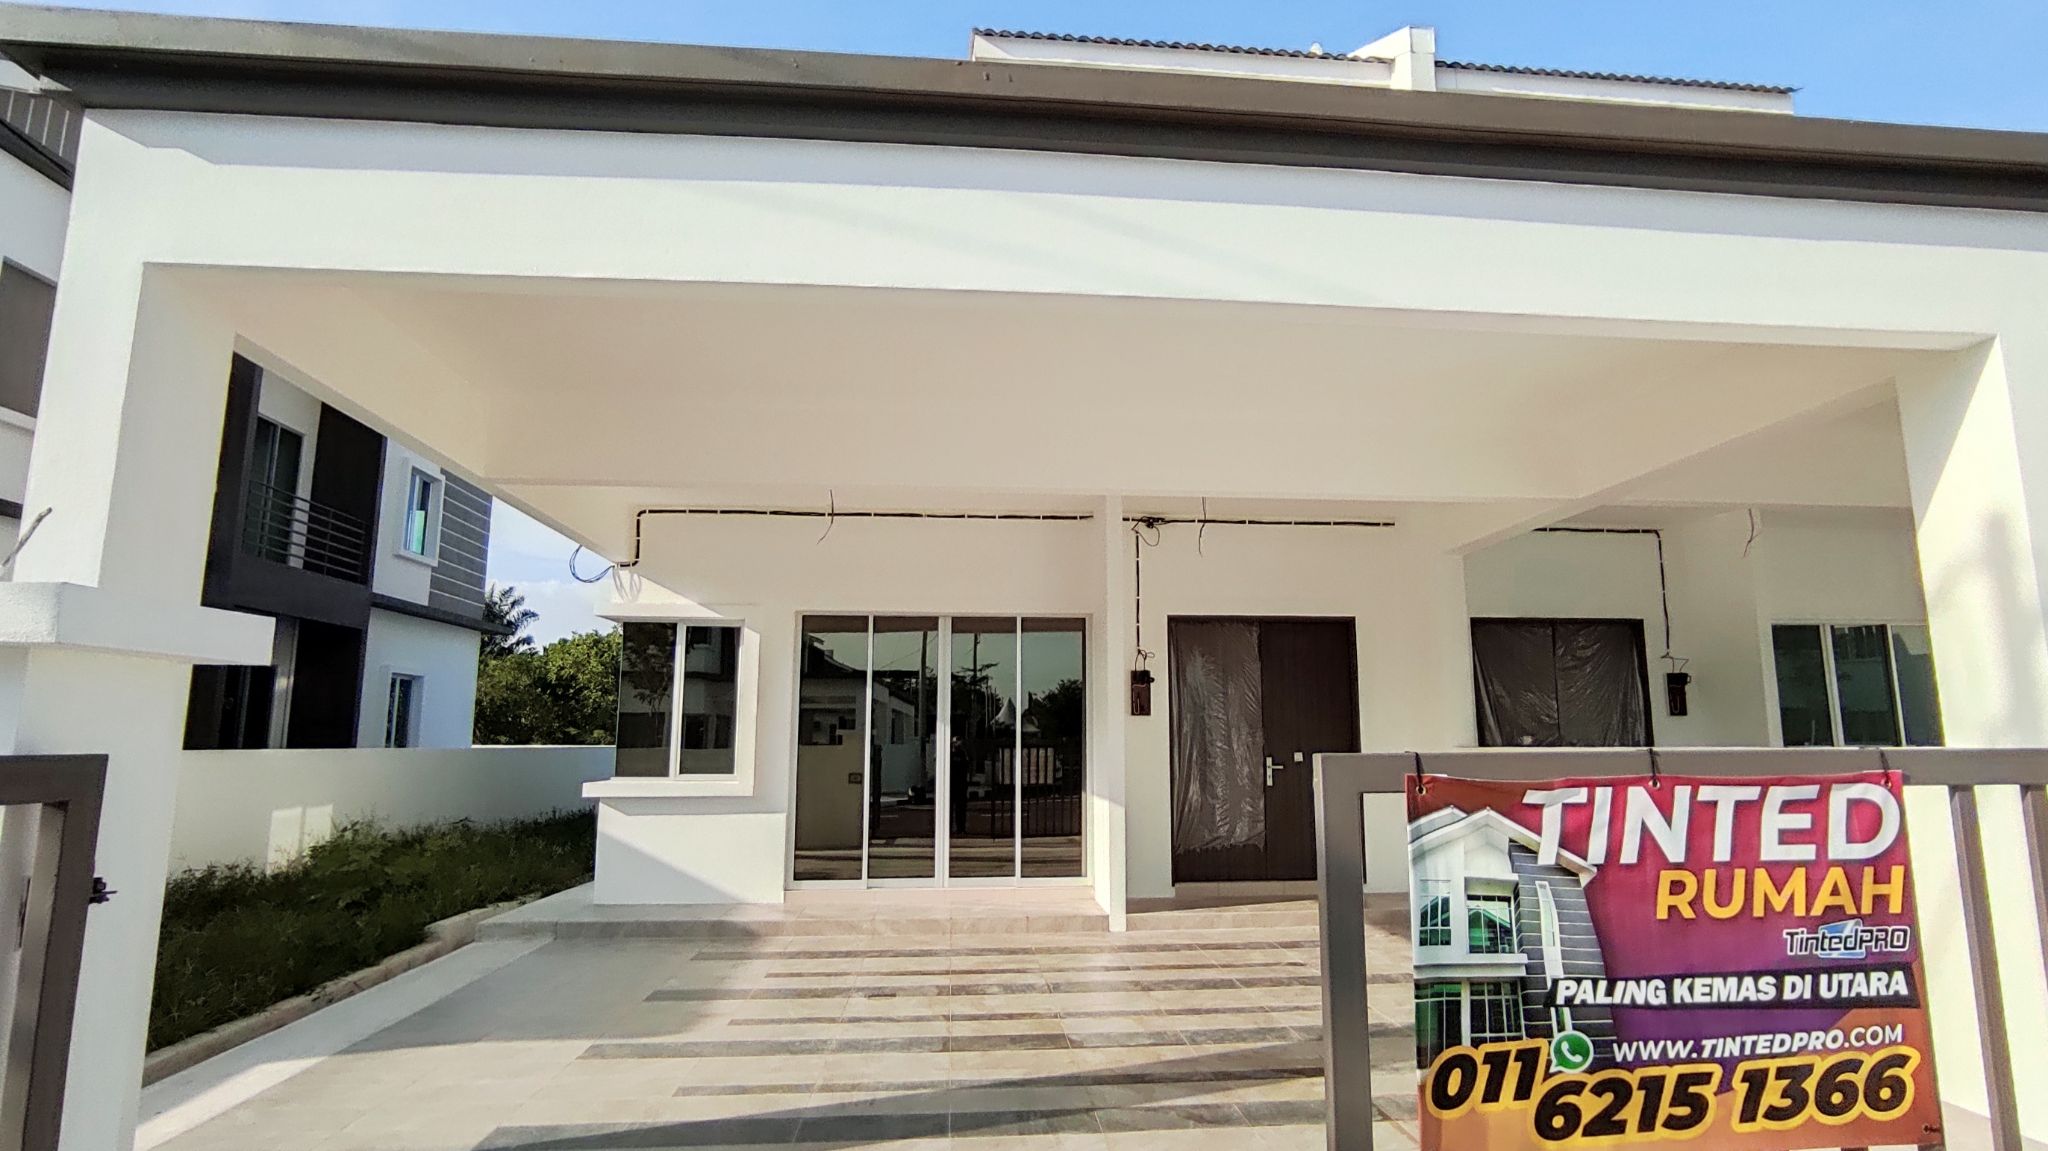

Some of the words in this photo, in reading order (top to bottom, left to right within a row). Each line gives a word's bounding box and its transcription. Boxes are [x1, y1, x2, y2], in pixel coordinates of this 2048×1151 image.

[1521, 783, 1900, 866] TINTED
[1656, 865, 1904, 920] RUMAH
[1783, 926, 1910, 955] TintedPRO
[1556, 976, 1667, 1006] PALING
[1674, 975, 1777, 1003] KEMAS
[1783, 973, 1811, 1000] DI
[1819, 970, 1908, 998] UTARA
[1612, 1023, 1903, 1063] WWW.TINTEDPRO.COM
[1430, 1045, 1542, 1111] 011
[1533, 1069, 1716, 1142] 6215
[1735, 1053, 1912, 1124] 1366
